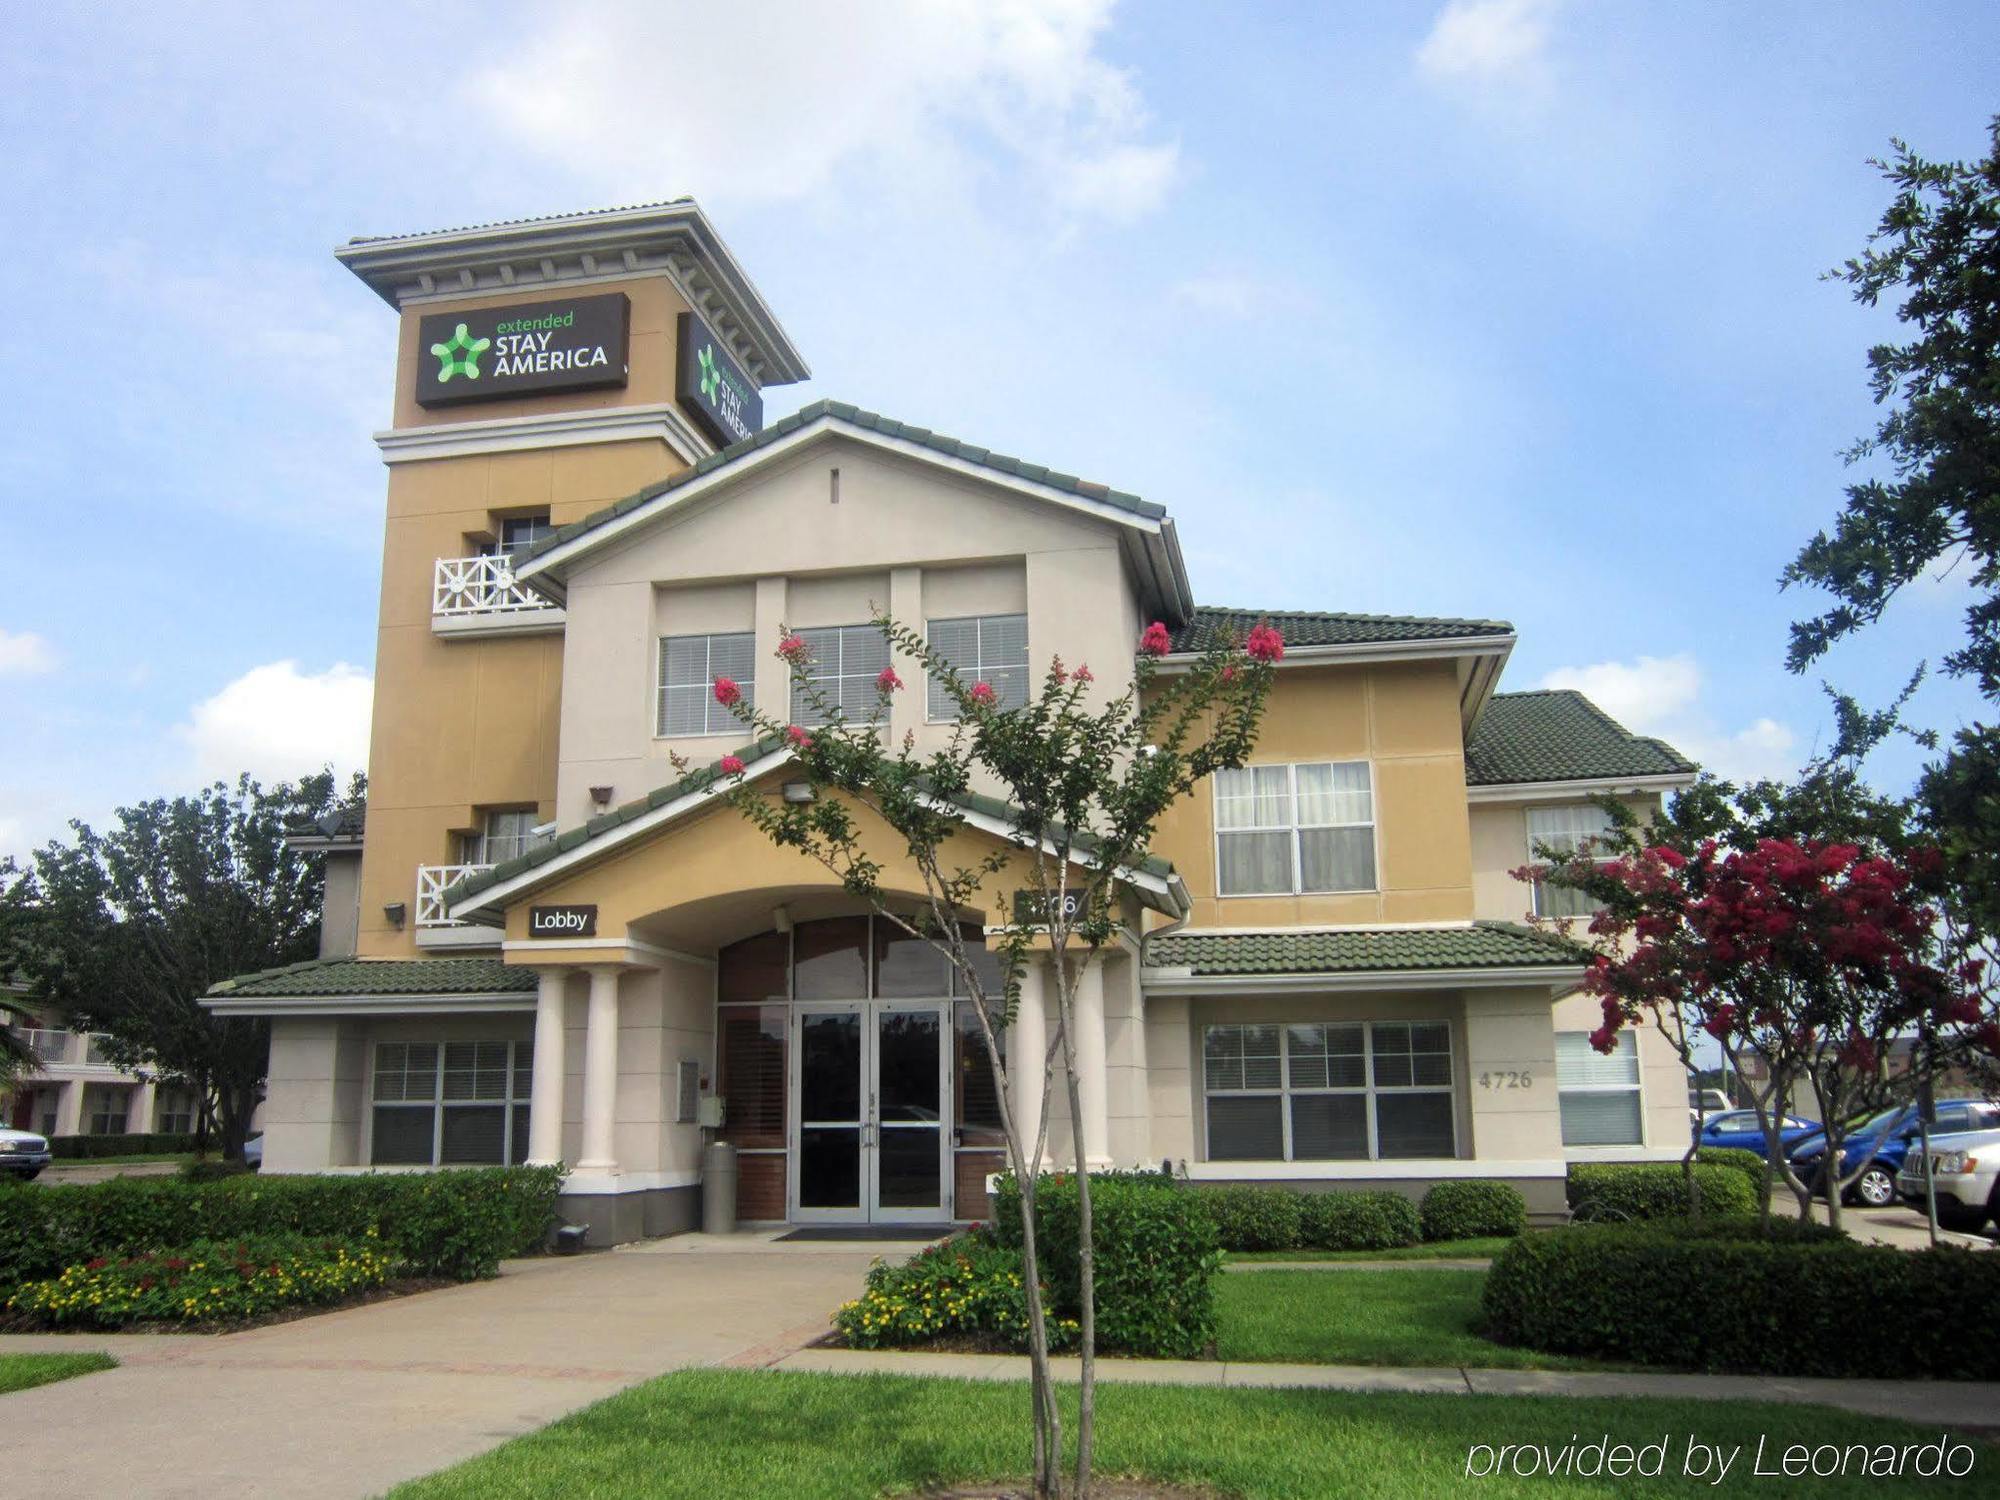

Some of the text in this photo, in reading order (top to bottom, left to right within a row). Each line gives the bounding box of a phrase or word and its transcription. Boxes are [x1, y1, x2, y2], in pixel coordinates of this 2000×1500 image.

[496, 310, 574, 334] extended
[495, 331, 553, 357] STAY
[493, 346, 609, 377] AMERICA
[721, 379, 742, 416] STAY
[534, 911, 588, 931] Lobby
[1479, 1070, 1532, 1089] 4726
